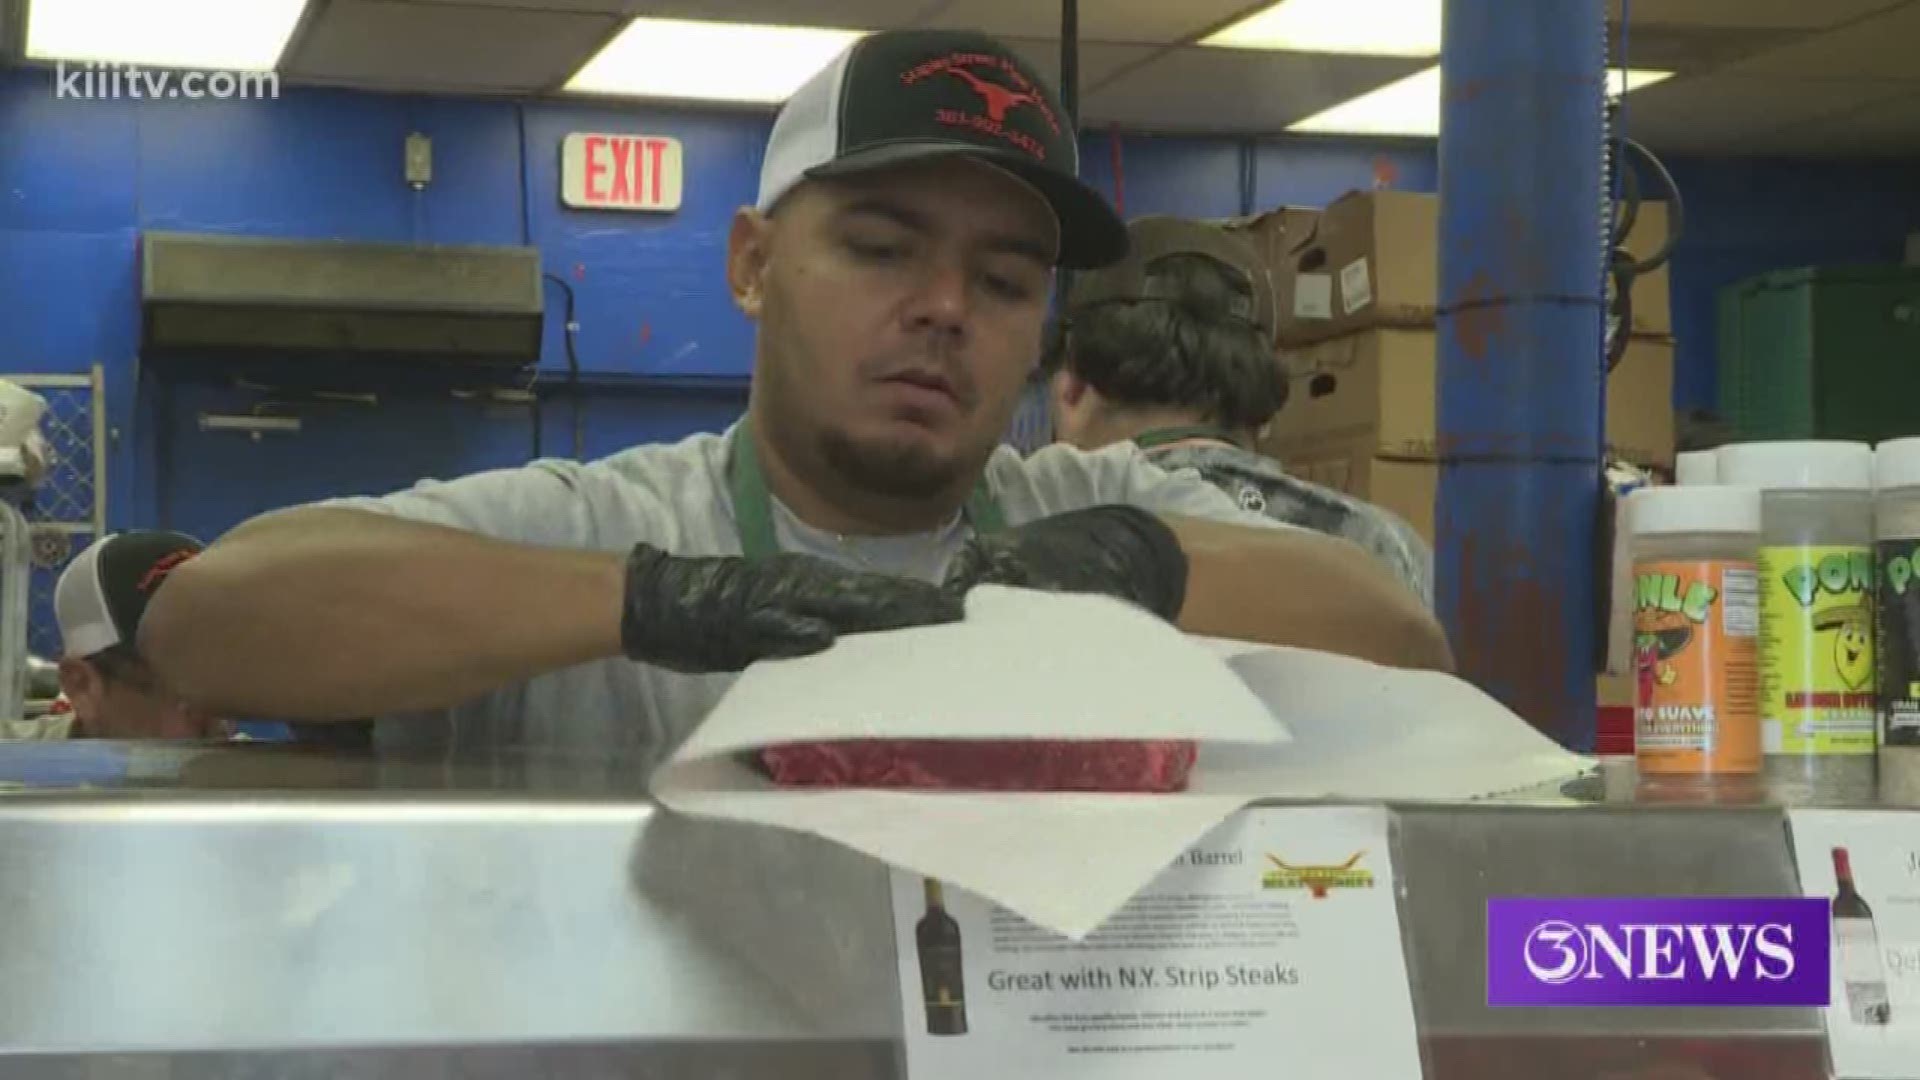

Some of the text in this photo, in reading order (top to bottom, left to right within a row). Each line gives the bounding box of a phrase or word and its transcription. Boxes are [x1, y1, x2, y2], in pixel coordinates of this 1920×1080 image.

[584, 137, 669, 204] EXIT
[987, 962, 1299, 992] Great with N.Y. Strip Steaks
